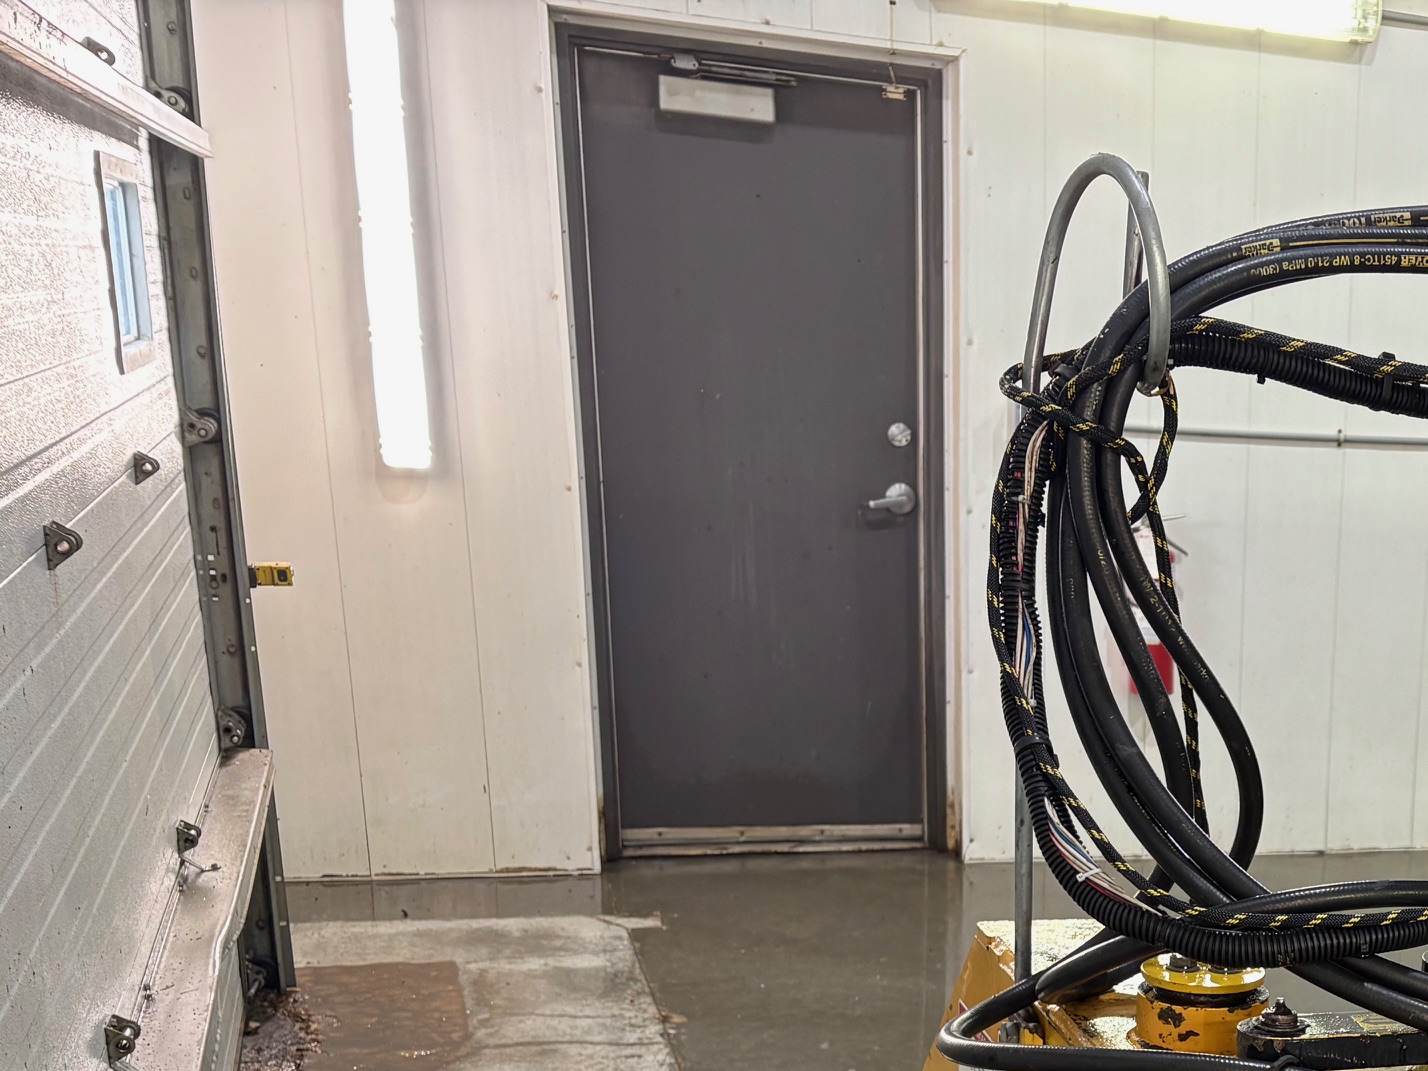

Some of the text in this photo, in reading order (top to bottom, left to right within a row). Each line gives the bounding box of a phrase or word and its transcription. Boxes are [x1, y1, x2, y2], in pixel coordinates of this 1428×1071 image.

[1372, 214, 1406, 226] Parker
[1244, 241, 1276, 254] Parker
[1282, 257, 1306, 270] MPa
[1308, 256, 1330, 268] 21,0
[1333, 255, 1350, 265] WP
[1354, 254, 1398, 266] 451TC-8
